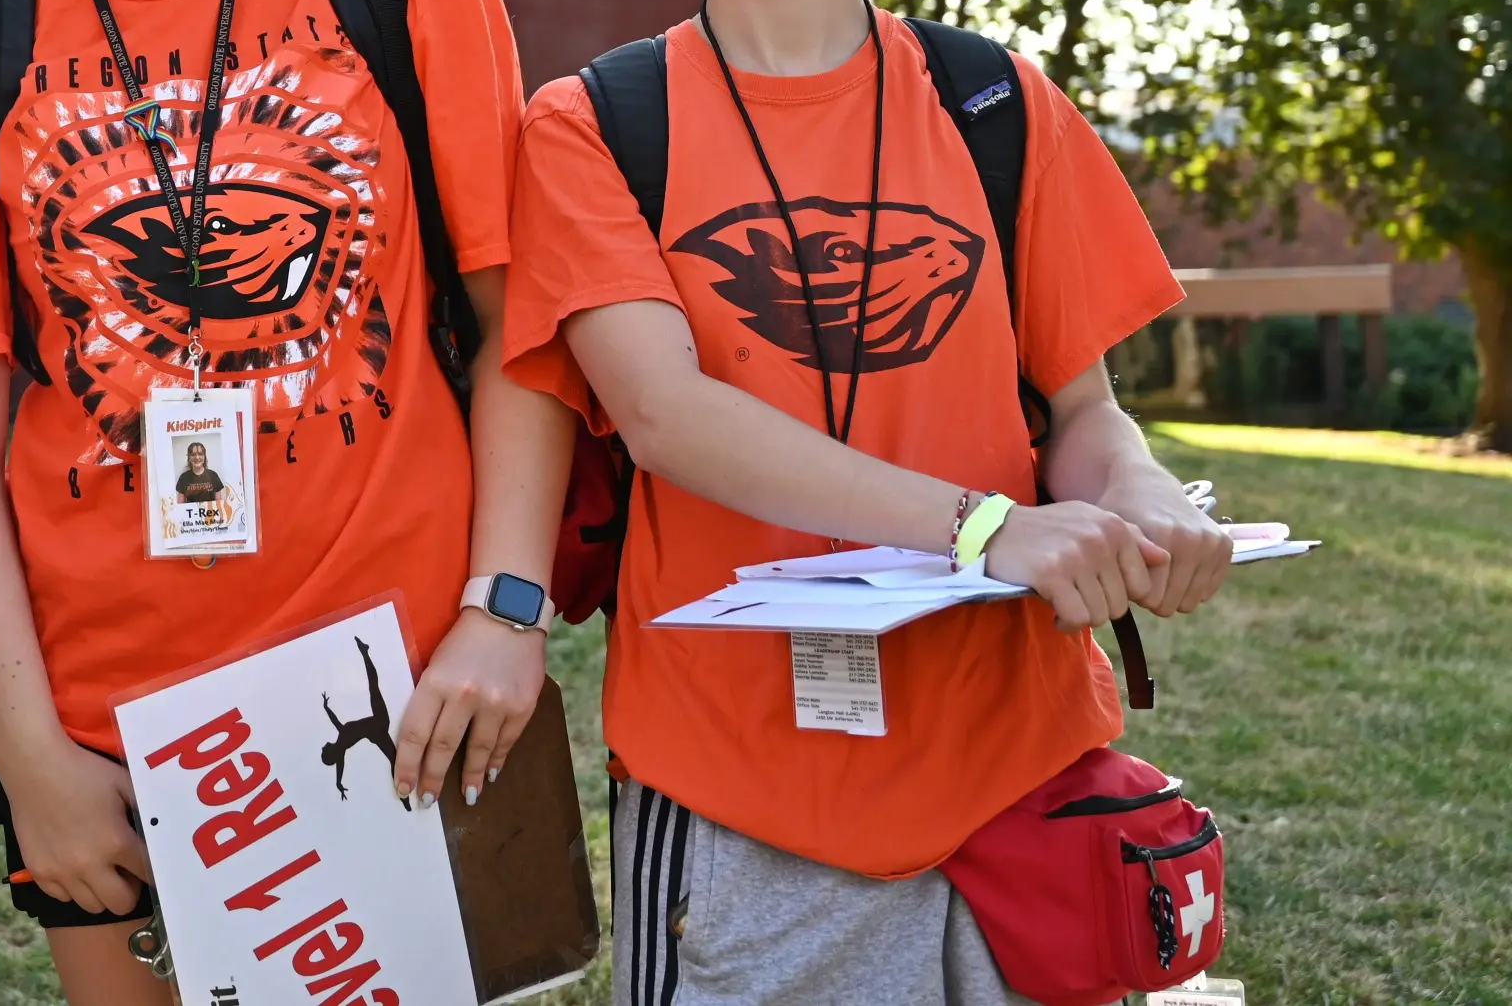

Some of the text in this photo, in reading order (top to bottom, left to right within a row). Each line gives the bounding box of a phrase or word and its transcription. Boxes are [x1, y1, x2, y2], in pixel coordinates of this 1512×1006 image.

[100, 9, 118, 45] OREGON
[112, 43, 128, 69] STATE
[213, 46, 225, 72] STATE
[35, 48, 181, 94] REGON
[207, 72, 223, 111] OREGON
[971, 89, 1011, 114] patagonia
[150, 145, 169, 181] OREGON
[162, 181, 179, 211] STATE
[196, 141, 211, 197] UNIVERSITY
[193, 196, 204, 226] STATE
[67, 388, 391, 499] BEERS
[166, 418, 223, 433] KidSpirit
[186, 508, 220, 519] T-Rex
[144, 707, 298, 869] Red
[224, 849, 321, 911] 1
